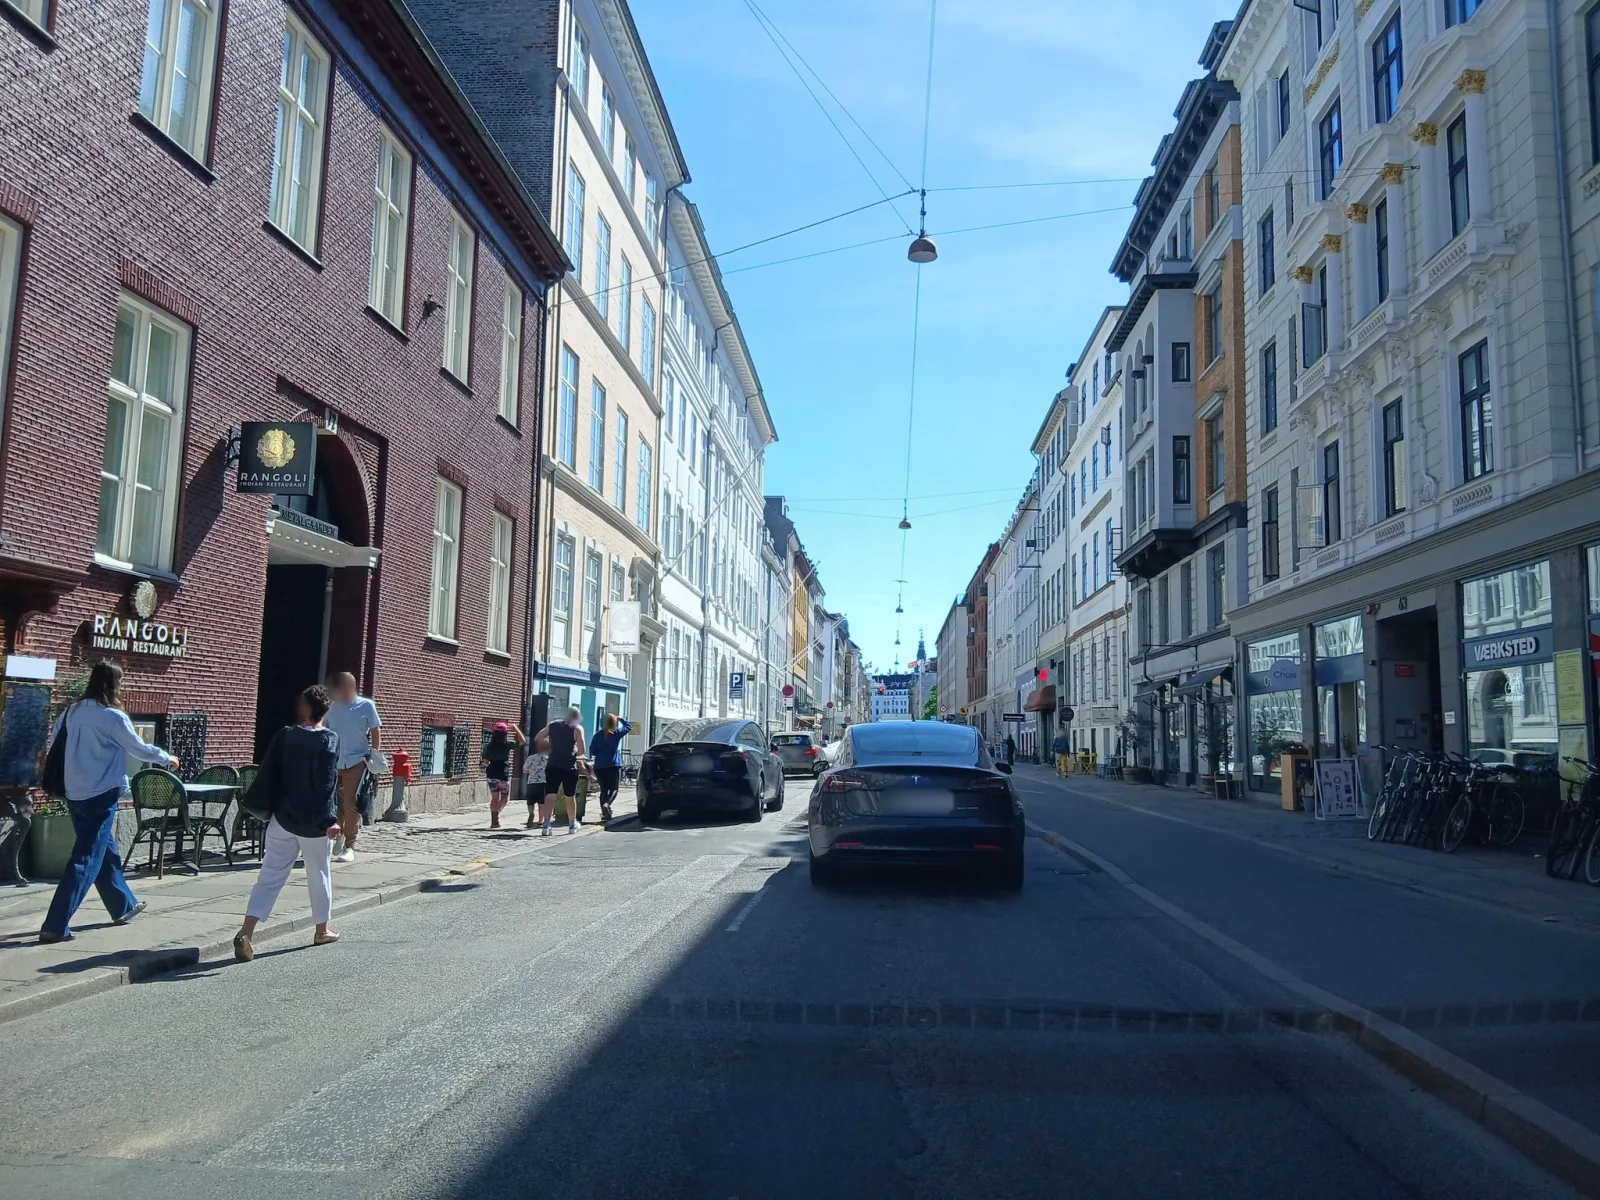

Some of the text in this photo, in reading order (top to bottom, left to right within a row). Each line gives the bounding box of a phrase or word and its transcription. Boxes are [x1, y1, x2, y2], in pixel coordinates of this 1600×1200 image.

[240, 472, 307, 482] RANGOLI
[93, 614, 188, 645] RANGOLI
[92, 636, 188, 657] INDIAN RESTAURANT
[1474, 637, 1537, 661] VÆRKSTED
[732, 674, 741, 688] P
[1333, 776, 1343, 810] OPEN
